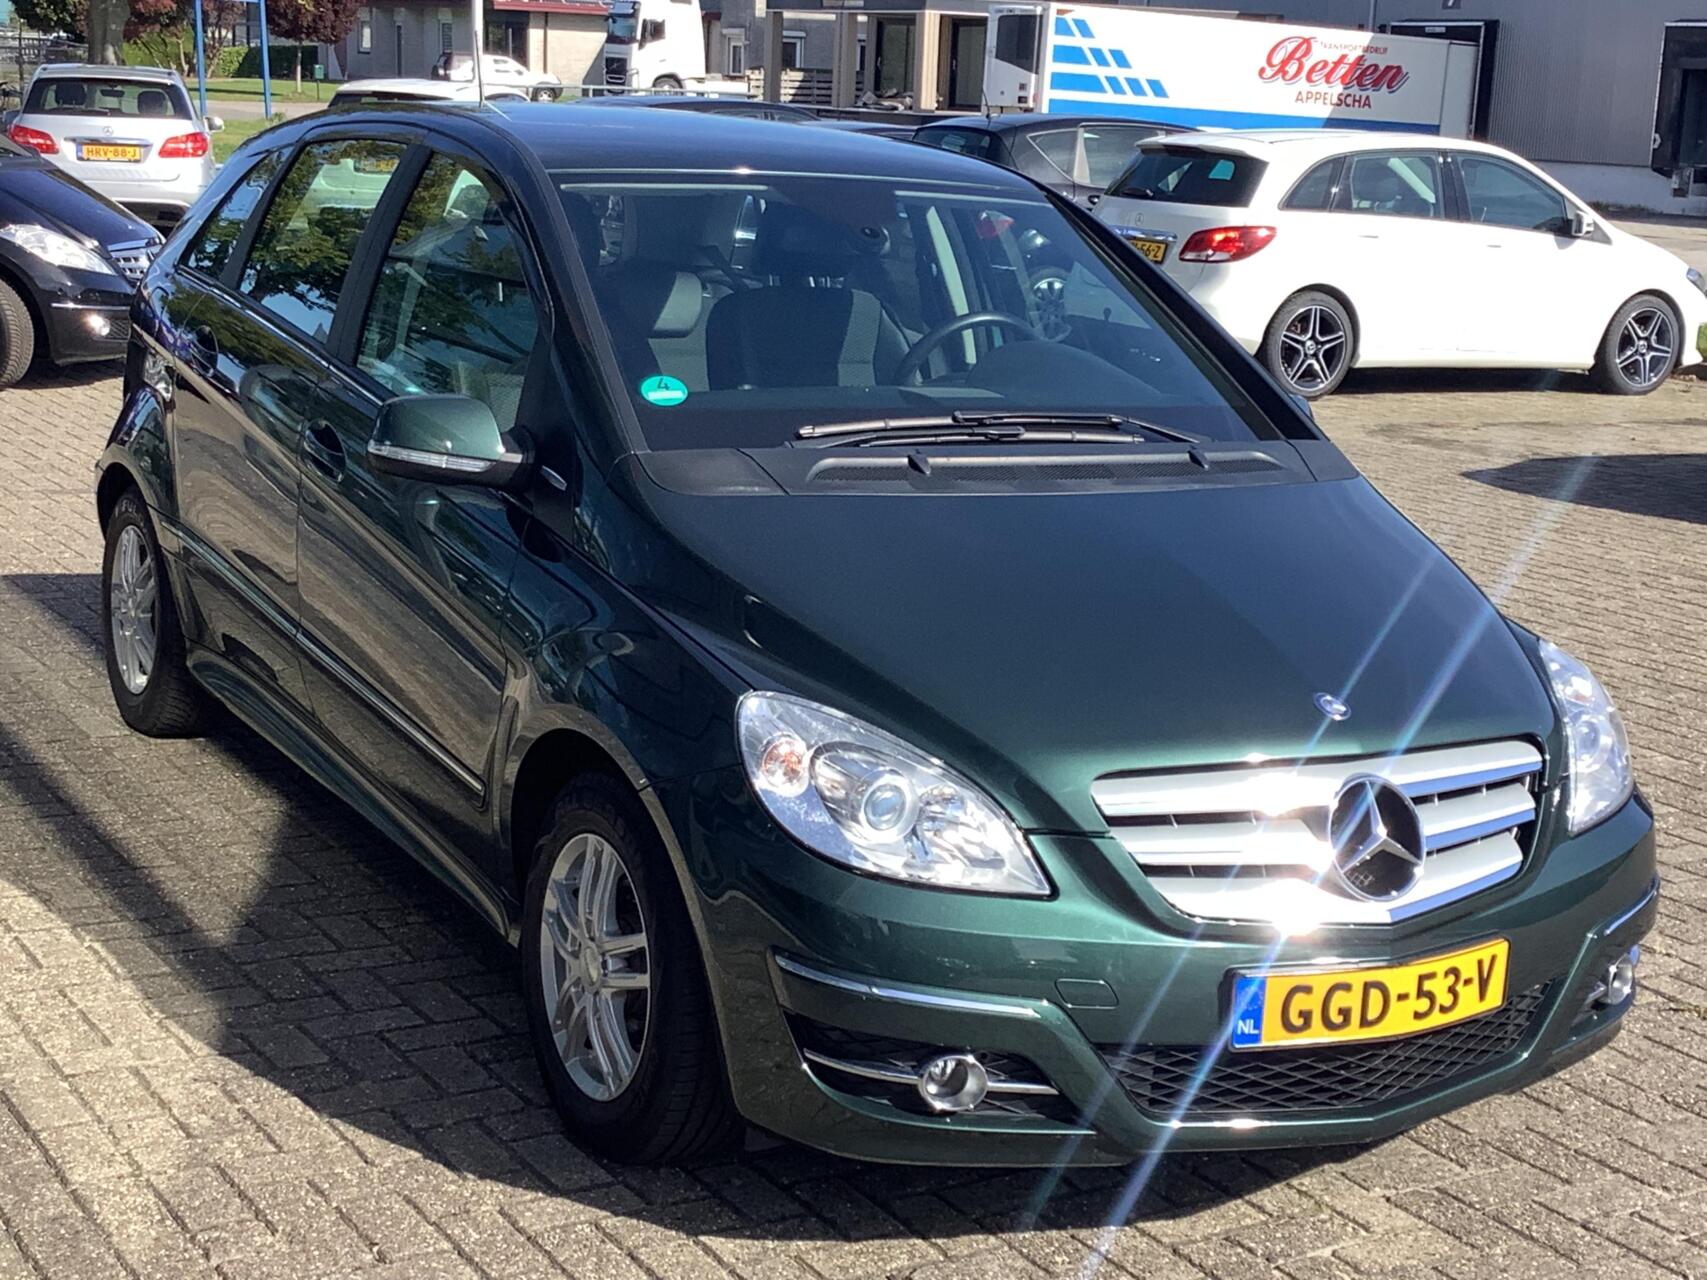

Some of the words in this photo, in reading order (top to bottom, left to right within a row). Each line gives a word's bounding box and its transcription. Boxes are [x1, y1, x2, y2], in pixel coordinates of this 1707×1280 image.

[1258, 36, 1409, 93] Betten
[1294, 91, 1372, 109] APPELSCHA
[1280, 953, 1498, 1034] GGD-53-V
[1237, 1018, 1260, 1035] NL
